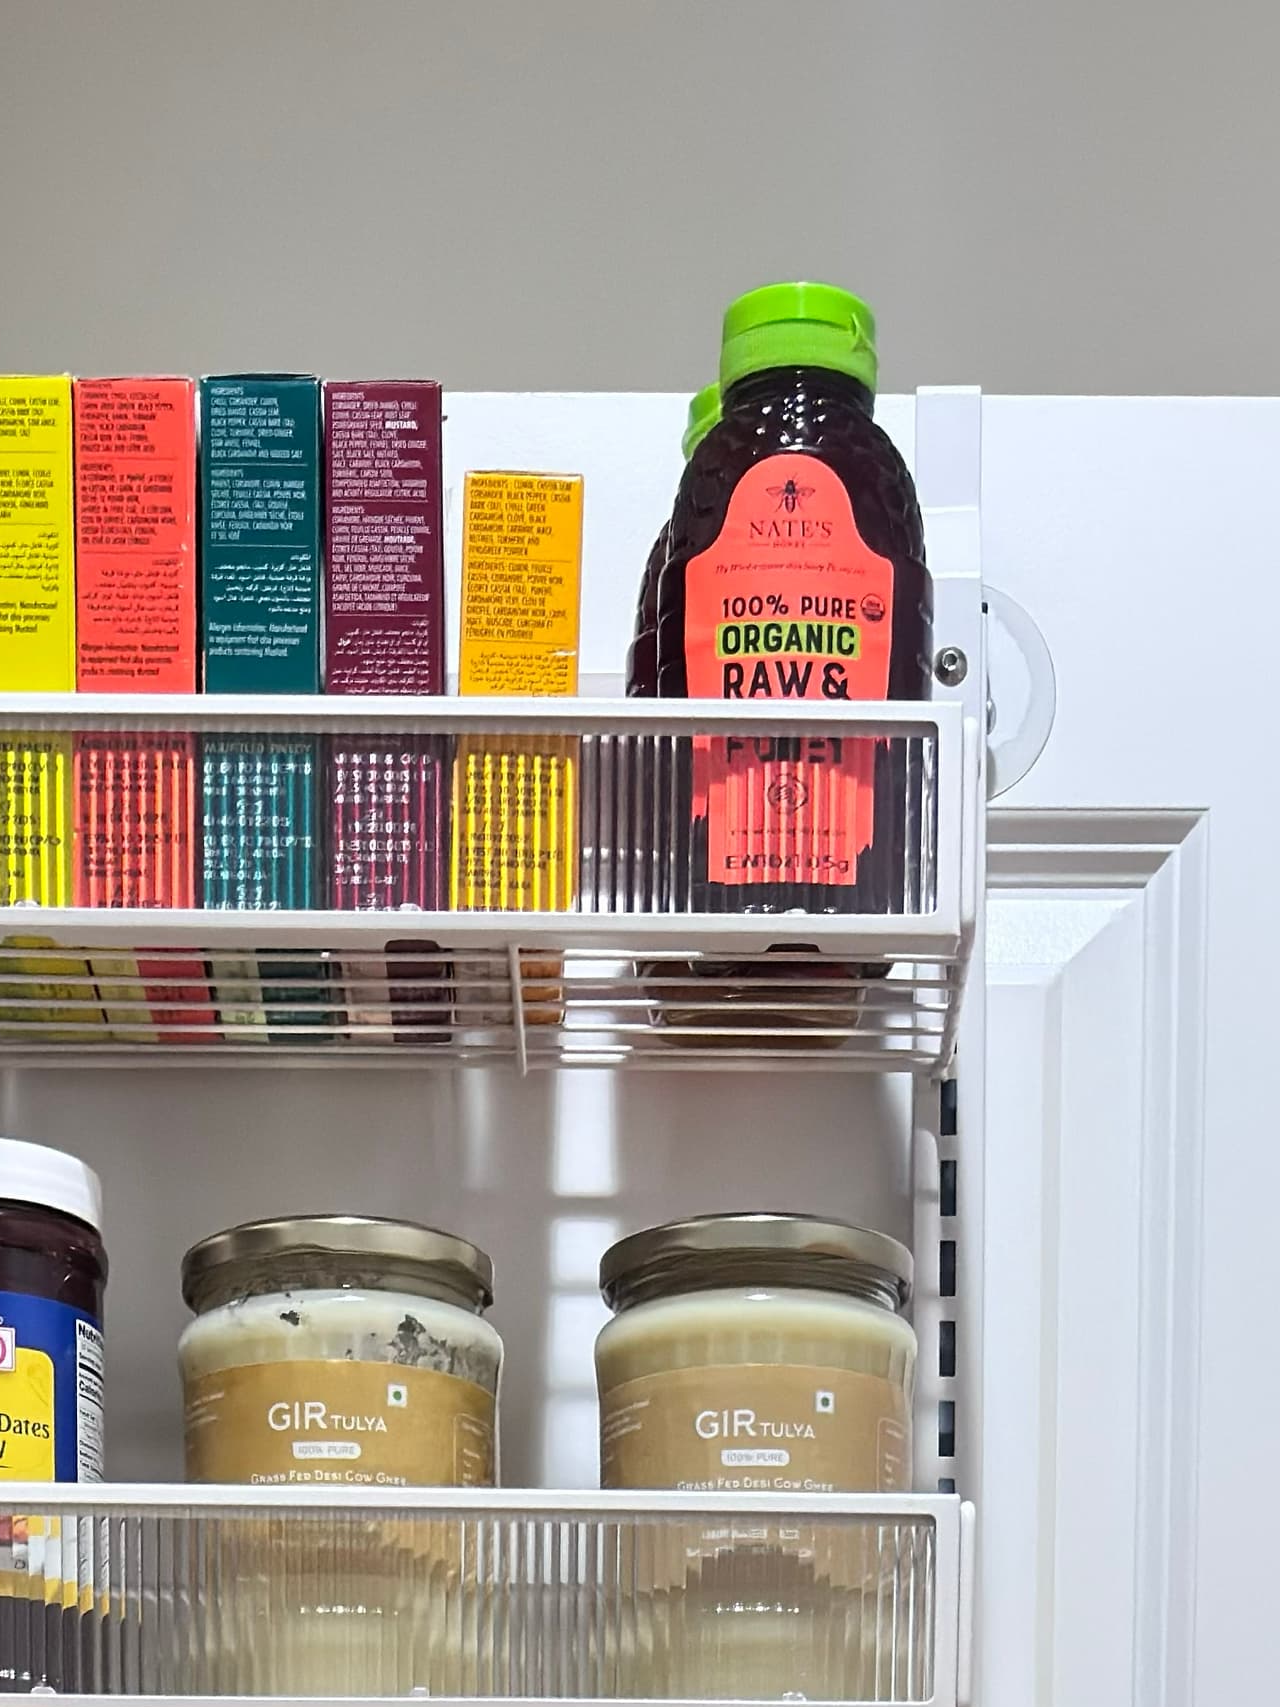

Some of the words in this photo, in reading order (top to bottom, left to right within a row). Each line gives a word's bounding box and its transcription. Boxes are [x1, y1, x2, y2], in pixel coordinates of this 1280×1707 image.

[749, 520, 833, 540] NATE'S
[723, 594, 788, 618] 100%
[801, 597, 856, 619] PURE
[722, 623, 855, 655] ORGANIC
[723, 661, 813, 699] RAW
[822, 663, 849, 700] &
[268, 1401, 327, 1431] GIR
[331, 1415, 387, 1433] TULYA
[695, 1408, 757, 1439] GIR
[760, 1422, 816, 1439] TULYA
